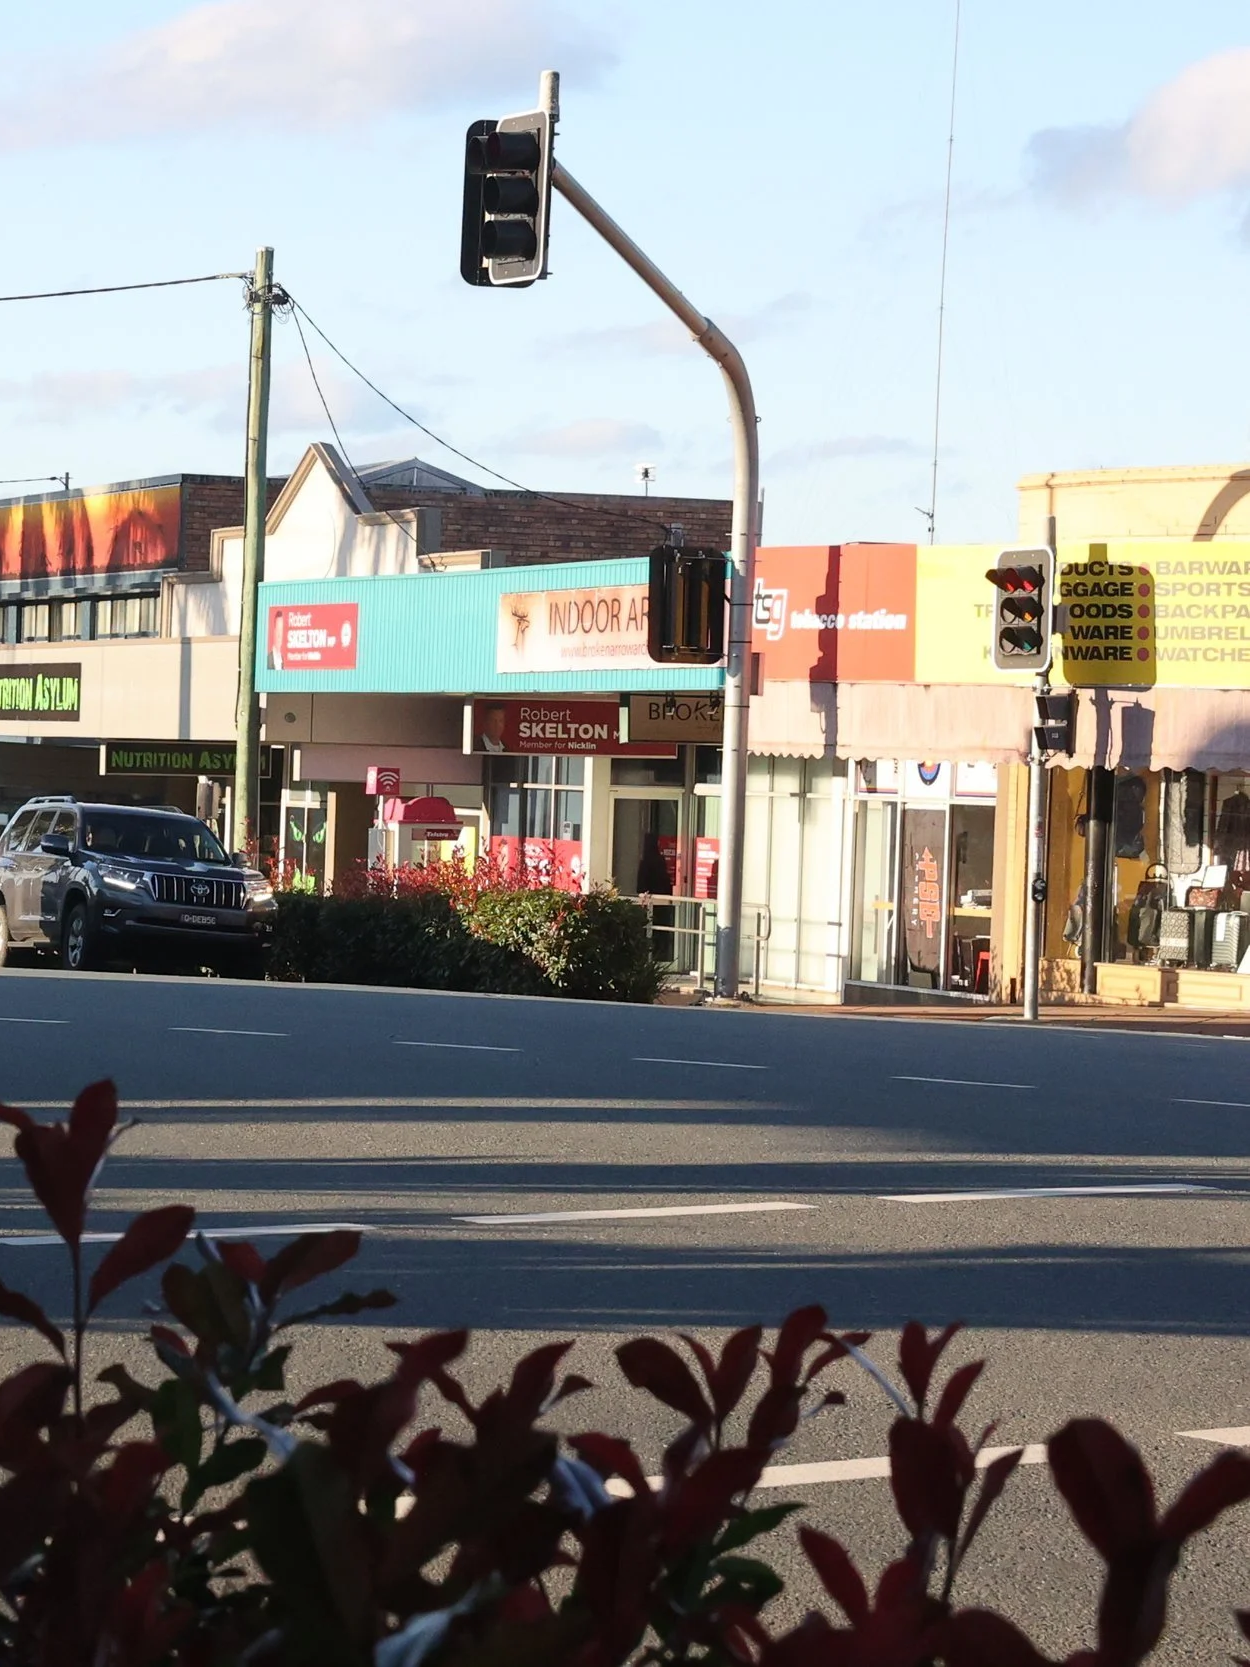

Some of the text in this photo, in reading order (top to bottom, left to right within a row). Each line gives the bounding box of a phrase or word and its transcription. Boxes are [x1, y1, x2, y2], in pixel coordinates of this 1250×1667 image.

[1059, 561, 1134, 576] DUCTS
[1059, 581, 1134, 597] GGAGE
[549, 598, 621, 635] INDOOR
[1069, 603, 1134, 618] OODS
[288, 611, 312, 627] Robert
[790, 608, 907, 630] tobacco station
[287, 629, 327, 648] SKELTON
[1069, 626, 1133, 641] WARE
[1056, 646, 1133, 661] NWARE
[520, 707, 571, 721] Robert
[518, 722, 621, 739] SKELTON M
[519, 740, 597, 750] Member for Nicklin
